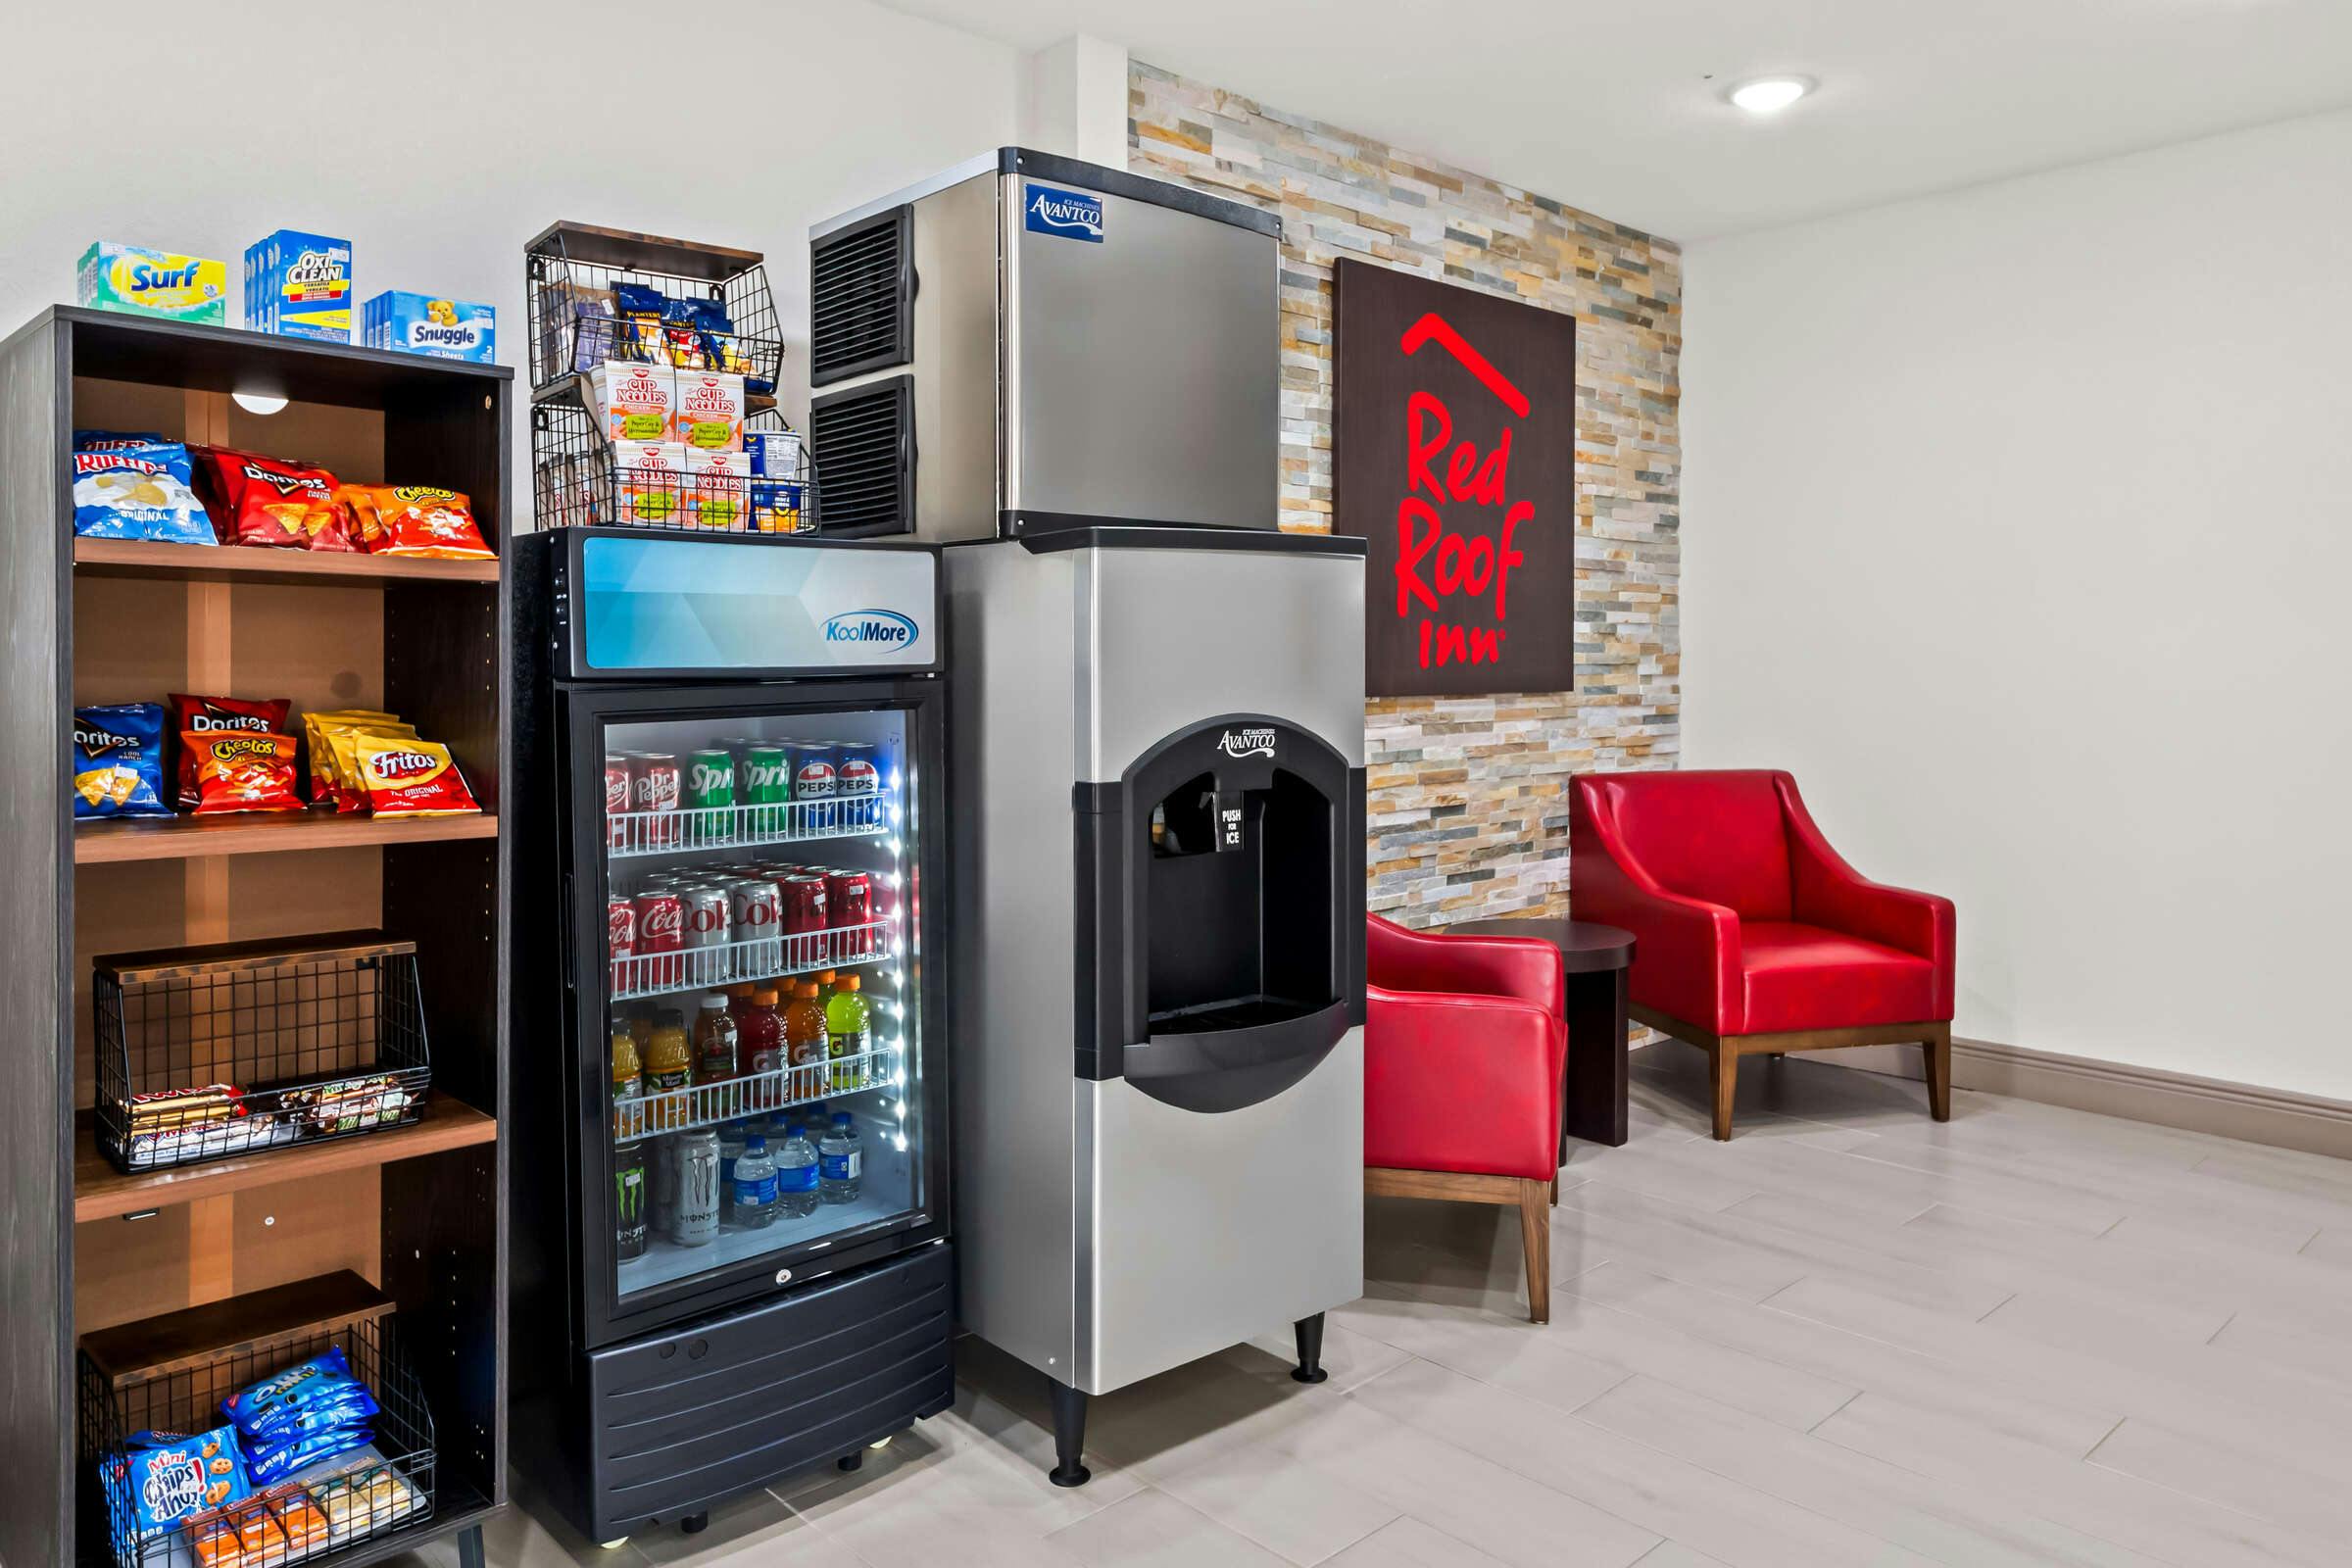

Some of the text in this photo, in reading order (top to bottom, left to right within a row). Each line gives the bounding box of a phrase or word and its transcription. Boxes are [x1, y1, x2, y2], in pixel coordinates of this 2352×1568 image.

[300, 253, 331, 270] OXI
[131, 262, 200, 291] Surf
[289, 266, 341, 283] CLEAN
[415, 326, 475, 345] Snuggle
[626, 378, 658, 392] CUP
[697, 387, 725, 401] CUP
[617, 389, 667, 404] NOODLES
[685, 398, 736, 413] NOODLES
[1407, 391, 1513, 506] Red
[639, 458, 667, 472] CUP
[1396, 496, 1536, 621] Roof
[826, 620, 906, 642] KoolMore
[193, 714, 270, 733] Doritos
[215, 740, 273, 760] Cheetos
[1216, 730, 1275, 752] AVANTCO
[369, 750, 436, 779] Fritos
[404, 784, 444, 797] ORIGINAL
[1222, 808, 1241, 822] PUSH
[1226, 831, 1240, 845] ICE
[148, 1450, 186, 1474] Mini
